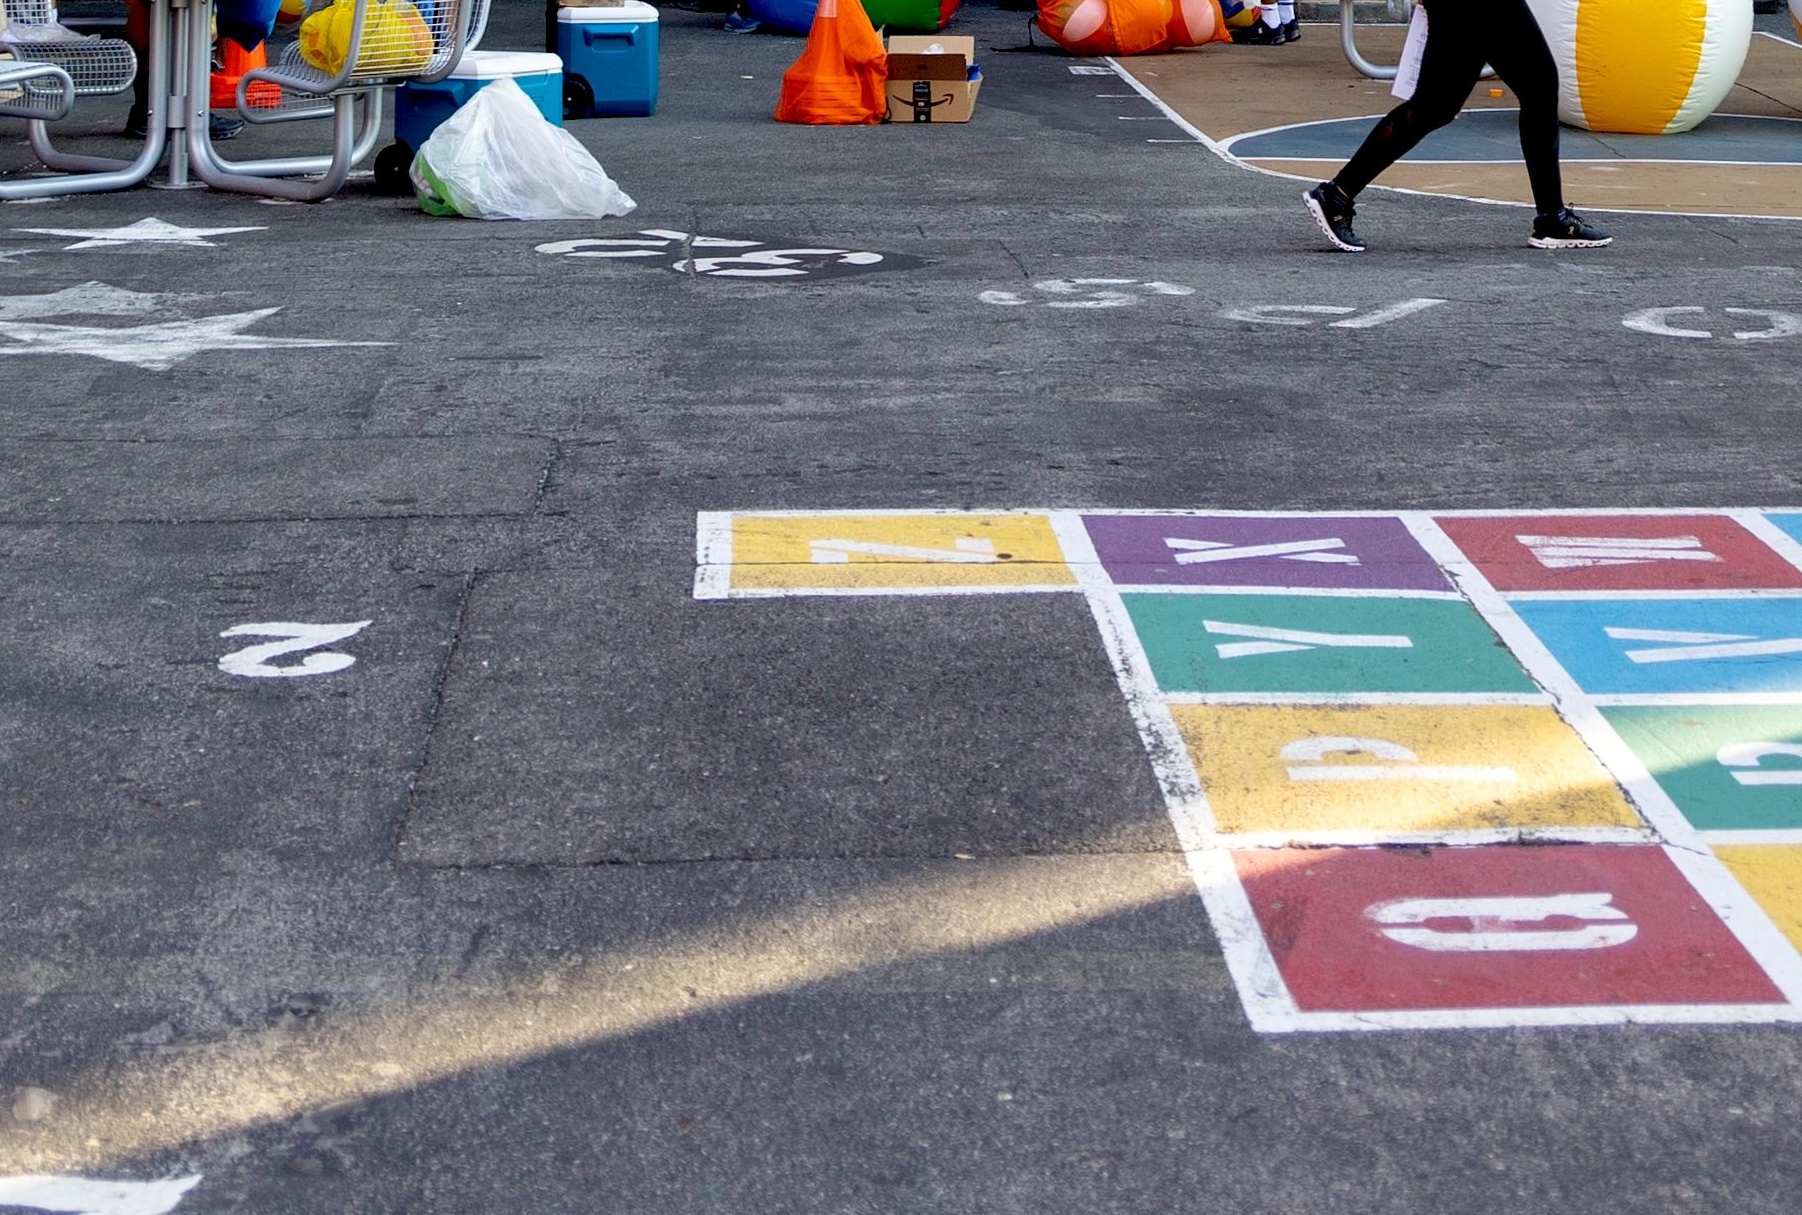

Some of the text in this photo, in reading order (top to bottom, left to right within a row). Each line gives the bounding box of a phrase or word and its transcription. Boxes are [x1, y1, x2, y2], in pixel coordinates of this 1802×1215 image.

[808, 536, 1033, 566] Z
[1165, 537, 1360, 566] X
[1517, 533, 1722, 569] W
[1204, 619, 1411, 658] Y
[1281, 736, 1517, 784] P
[1363, 893, 1639, 951] Q
